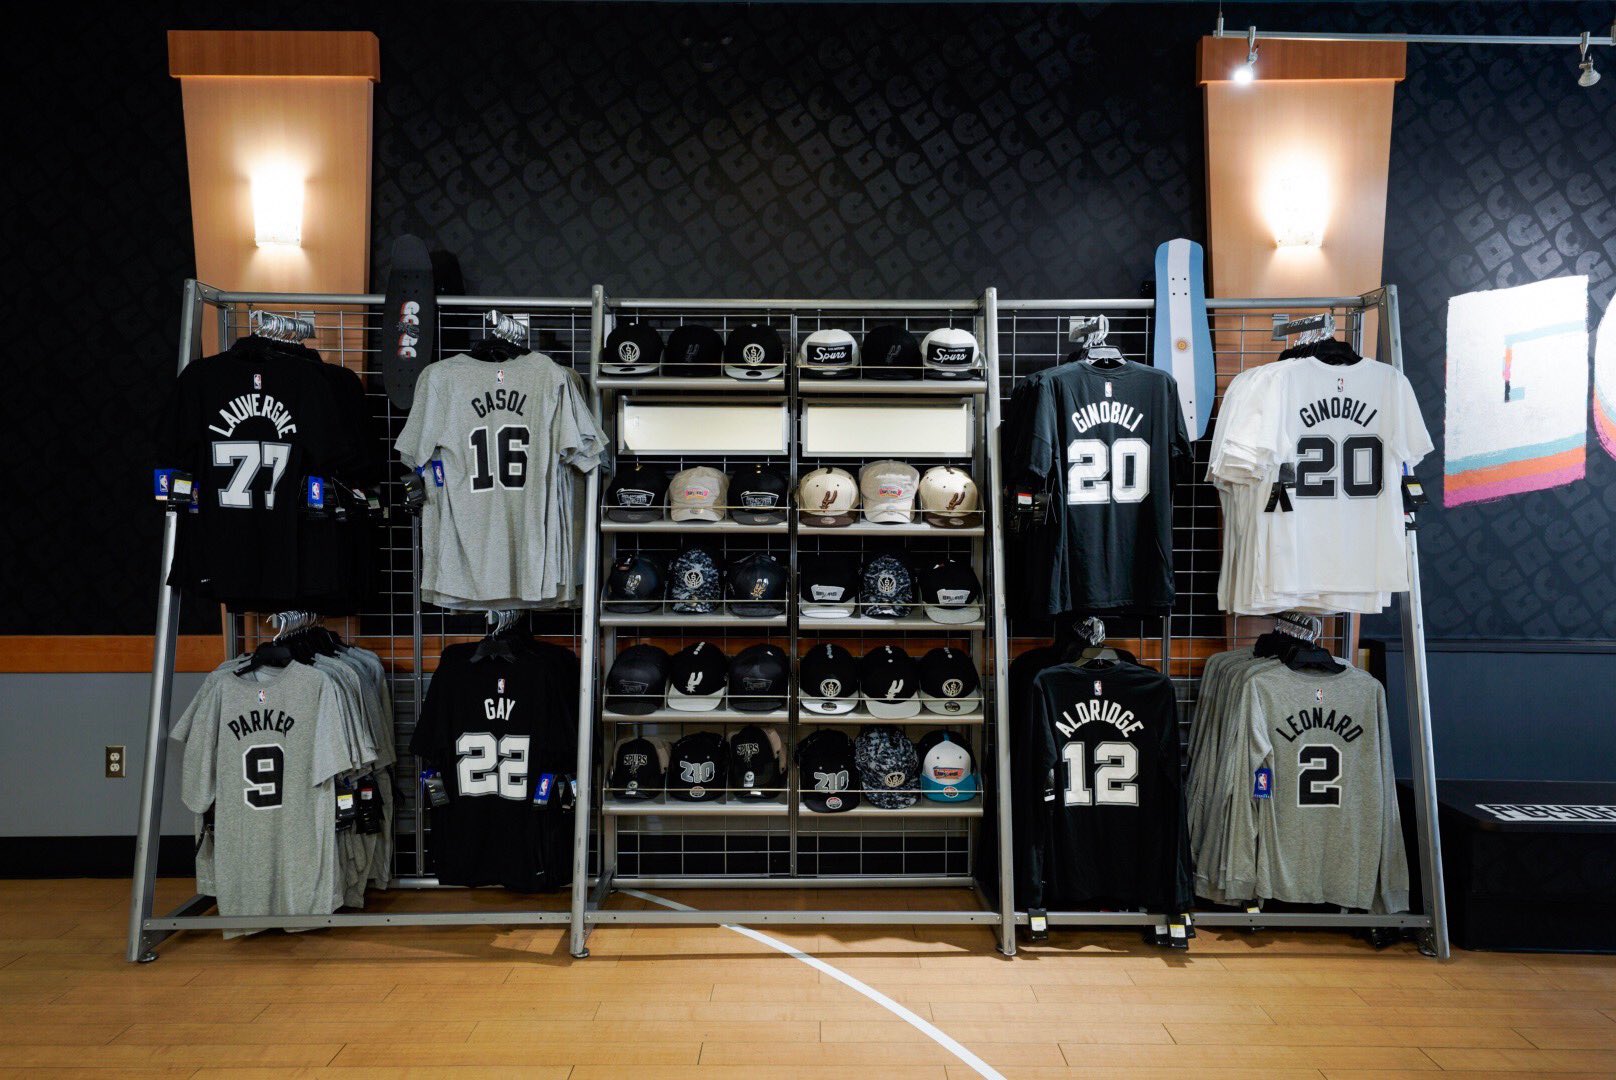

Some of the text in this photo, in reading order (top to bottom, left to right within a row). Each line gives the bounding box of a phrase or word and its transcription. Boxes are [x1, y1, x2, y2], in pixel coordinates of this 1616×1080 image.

[814, 347, 847, 363] Spurs
[933, 348, 967, 363] Spurs
[208, 393, 297, 439] LAUVERGNE
[471, 388, 528, 419] GASOL
[1071, 401, 1144, 433] GINOBILI
[1299, 397, 1378, 428] GINOBILI
[211, 440, 293, 510] 77
[469, 424, 531, 493] 16
[1067, 438, 1150, 505] 20
[1296, 433, 1384, 499] 20
[227, 709, 295, 741] PARKER
[484, 697, 516, 721] GAY
[1055, 699, 1145, 738] ALDRIDGE
[1275, 707, 1364, 743] LEONARD
[242, 743, 285, 810] 9
[456, 731, 531, 801] 22
[680, 760, 715, 784] 210
[814, 770, 850, 792] 210
[1062, 741, 1139, 807] 12
[1297, 743, 1342, 808] 2
